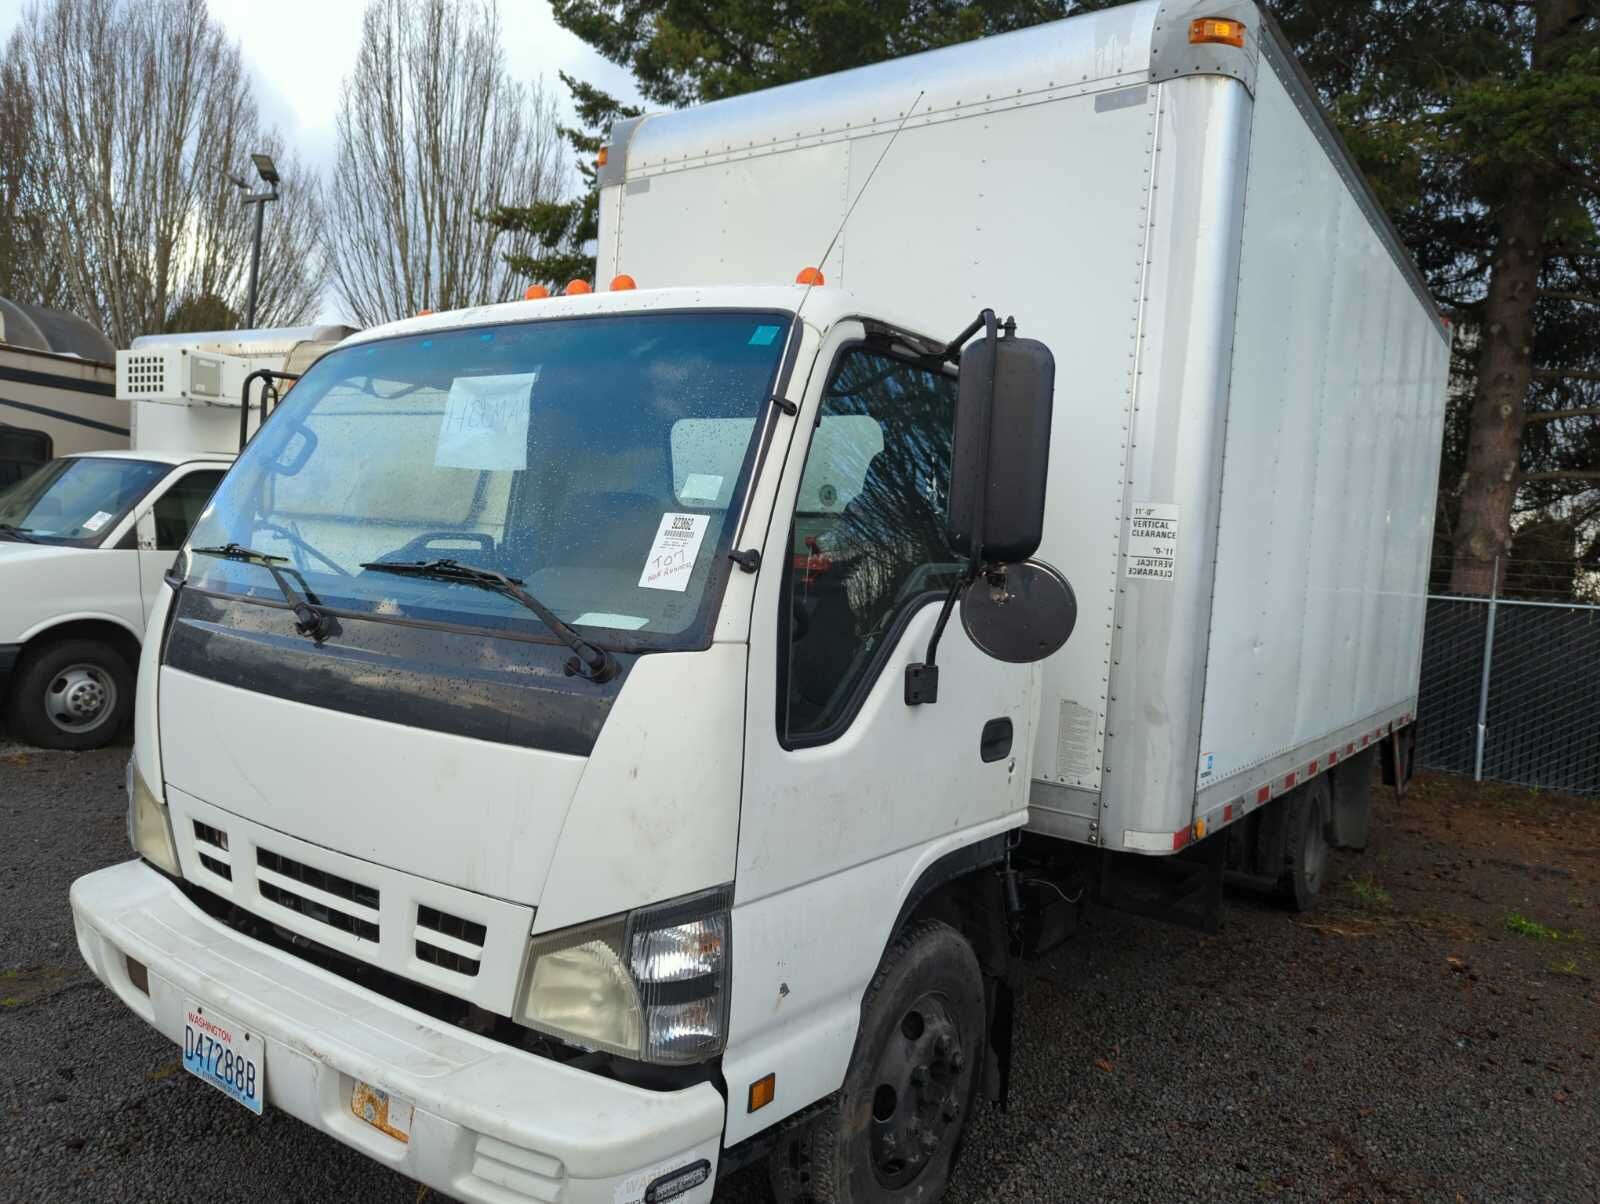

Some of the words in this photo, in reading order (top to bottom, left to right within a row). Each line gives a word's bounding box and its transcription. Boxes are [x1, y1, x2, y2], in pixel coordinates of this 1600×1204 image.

[1131, 529, 1176, 539] CLEARANCE
[1133, 520, 1169, 529] VERTICAL
[188, 1011, 232, 1044] WASHINGTON
[185, 1024, 256, 1100] D47288B
